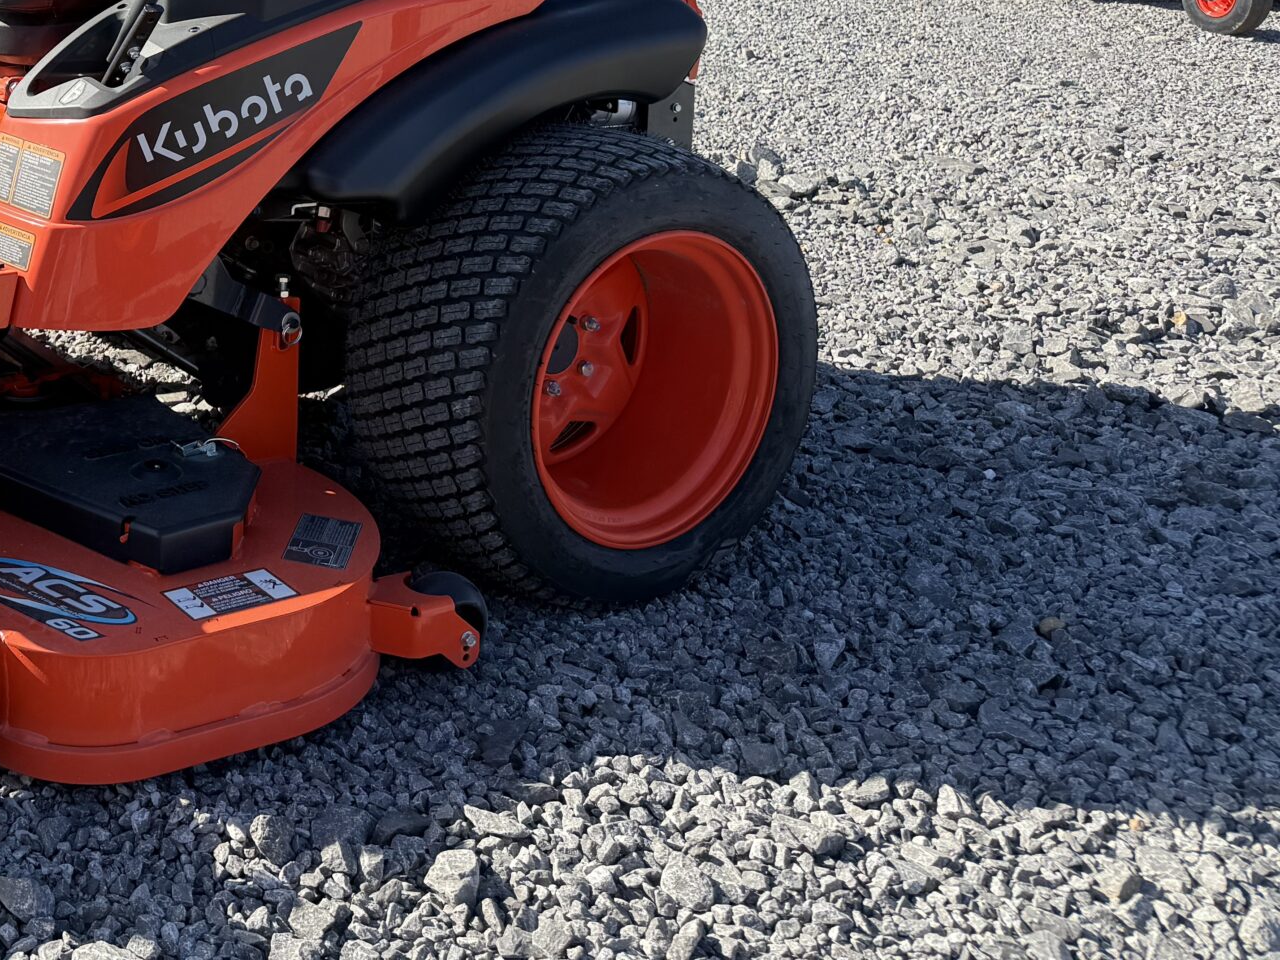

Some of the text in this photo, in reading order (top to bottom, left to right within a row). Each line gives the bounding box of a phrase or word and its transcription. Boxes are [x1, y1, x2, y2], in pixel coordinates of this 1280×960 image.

[136, 73, 314, 163] Kubota
[204, 575, 237, 588] DANGER
[219, 588, 253, 601] PELIGRO
[45, 618, 99, 639] 60
